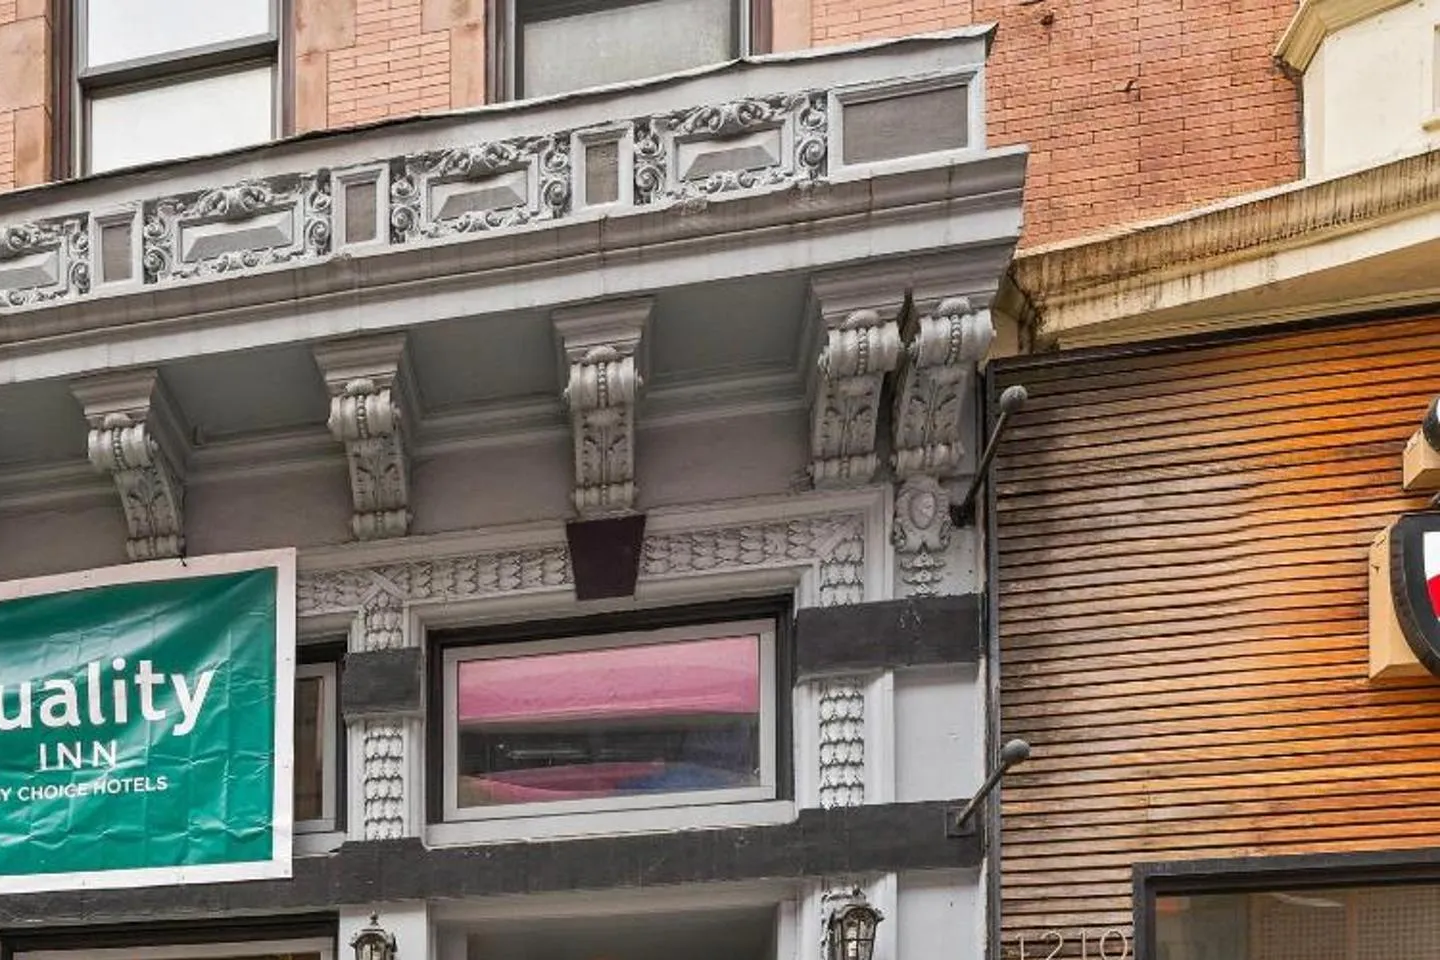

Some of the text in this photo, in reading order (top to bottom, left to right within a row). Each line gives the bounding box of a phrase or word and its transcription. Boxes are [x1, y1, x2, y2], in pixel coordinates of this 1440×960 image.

[39, 740, 117, 772] INN
[17, 780, 90, 803] CHOICE
[93, 775, 169, 796] HOTELS
